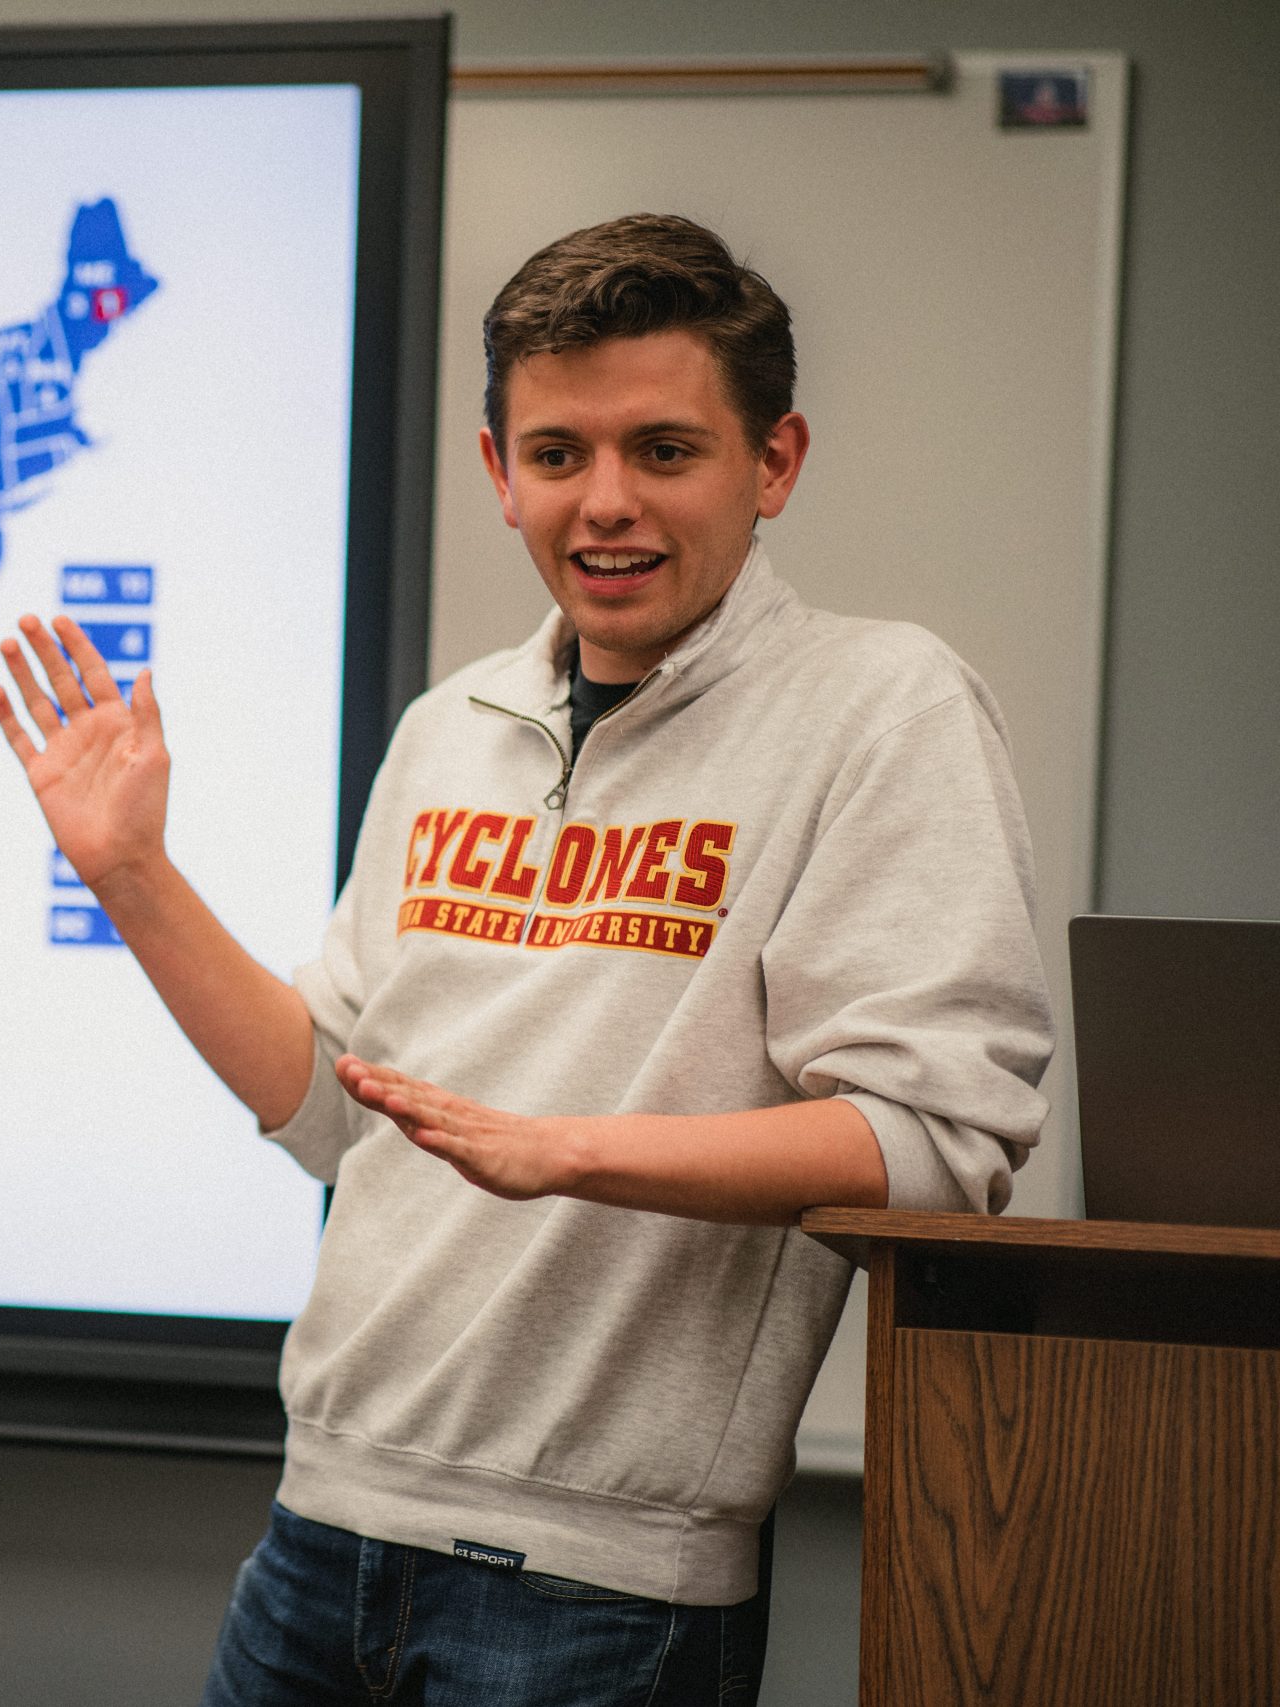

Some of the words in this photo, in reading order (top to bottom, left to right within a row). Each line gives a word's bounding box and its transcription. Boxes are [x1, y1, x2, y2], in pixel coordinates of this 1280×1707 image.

[404, 808, 737, 912] CYCLONES
[433, 902, 521, 941] STATE
[533, 914, 705, 952] UNIVERSITY
